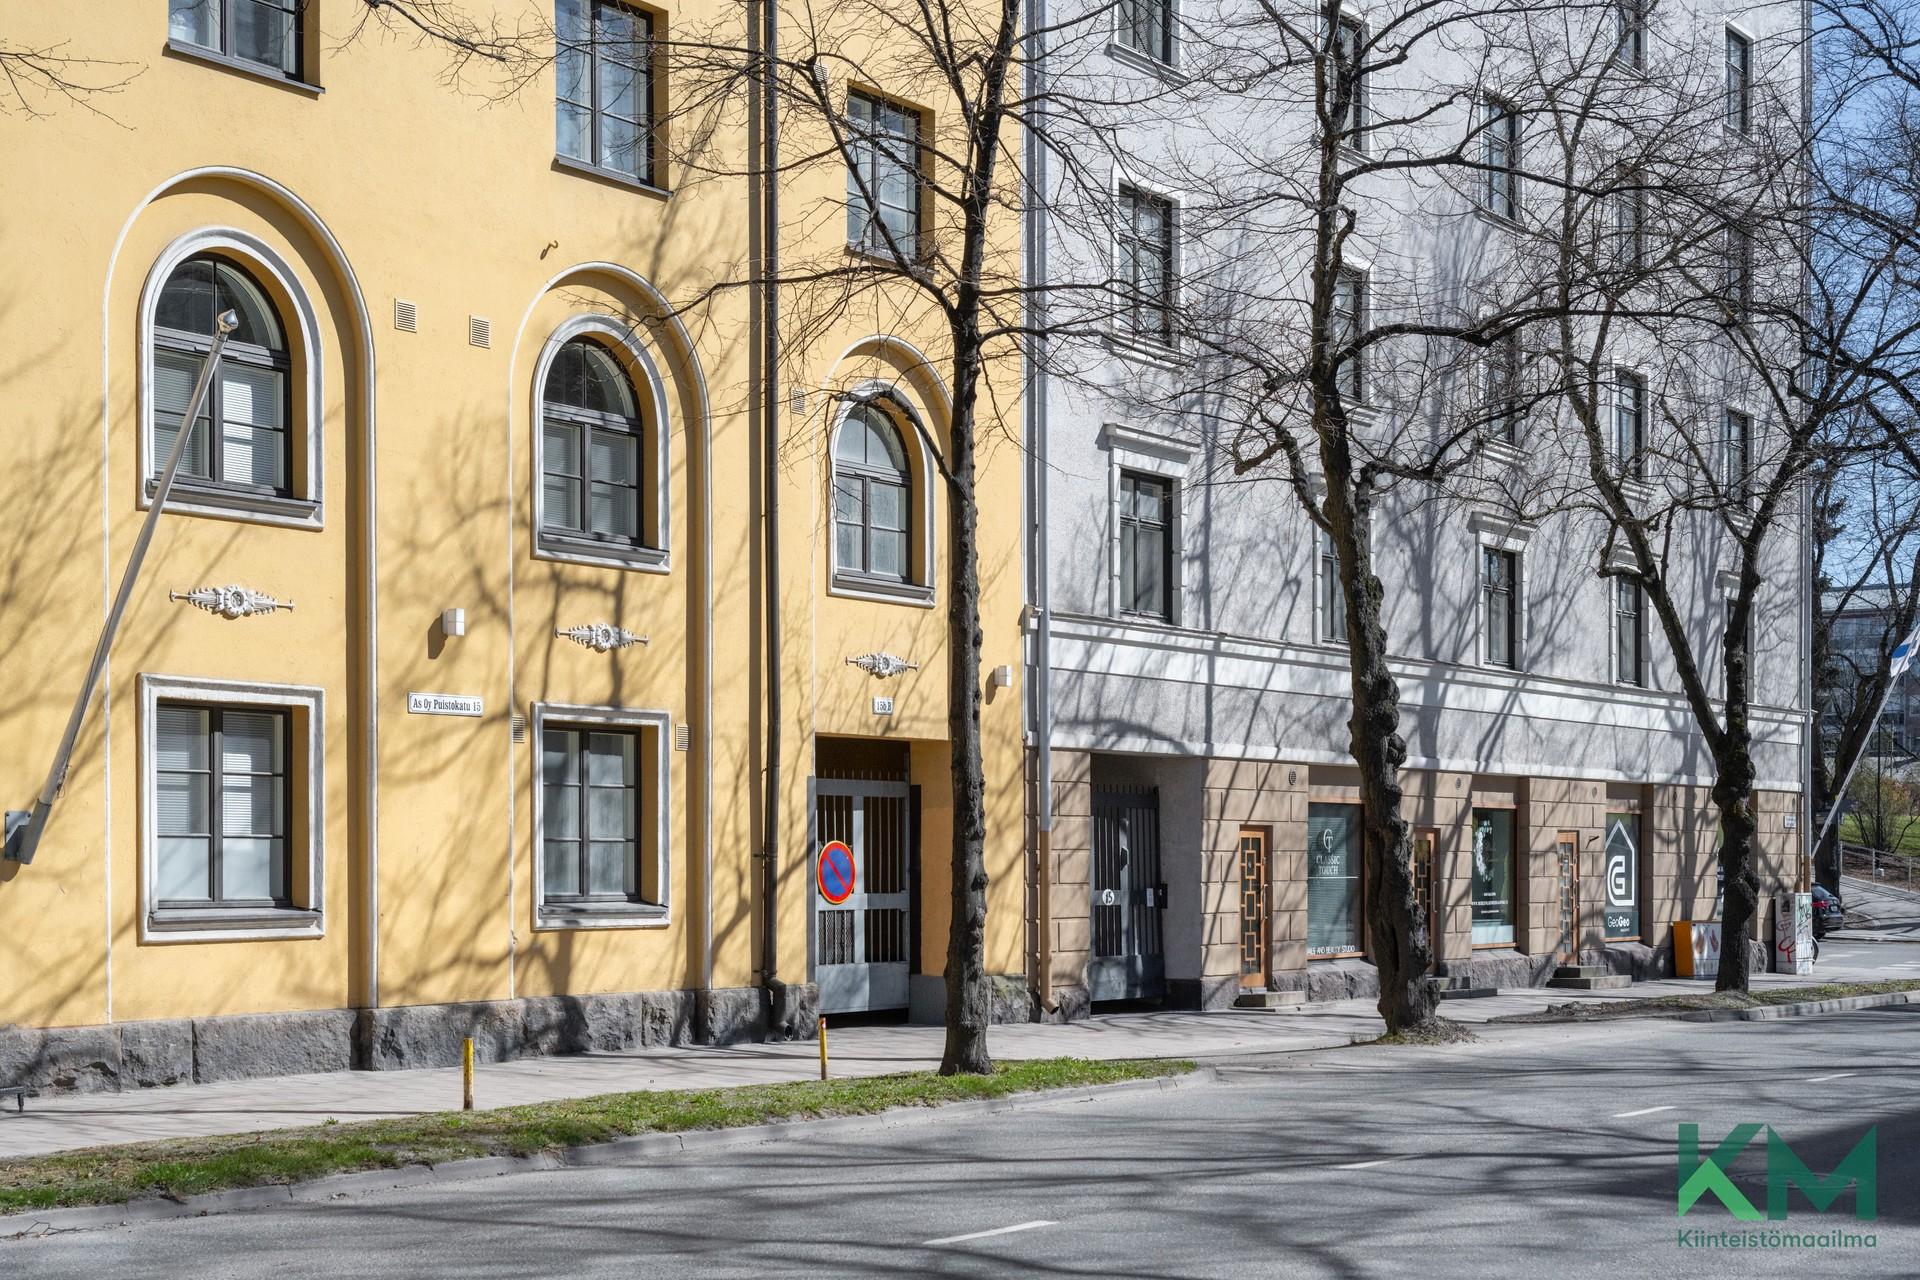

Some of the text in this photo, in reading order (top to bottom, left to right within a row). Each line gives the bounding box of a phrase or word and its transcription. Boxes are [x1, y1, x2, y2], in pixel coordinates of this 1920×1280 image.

[413, 698, 481, 712] As Oy Puistokatu 15
[887, 701, 892, 711] B
[1105, 891, 1113, 904] 15
[1607, 915, 1630, 928] GeoGeo
